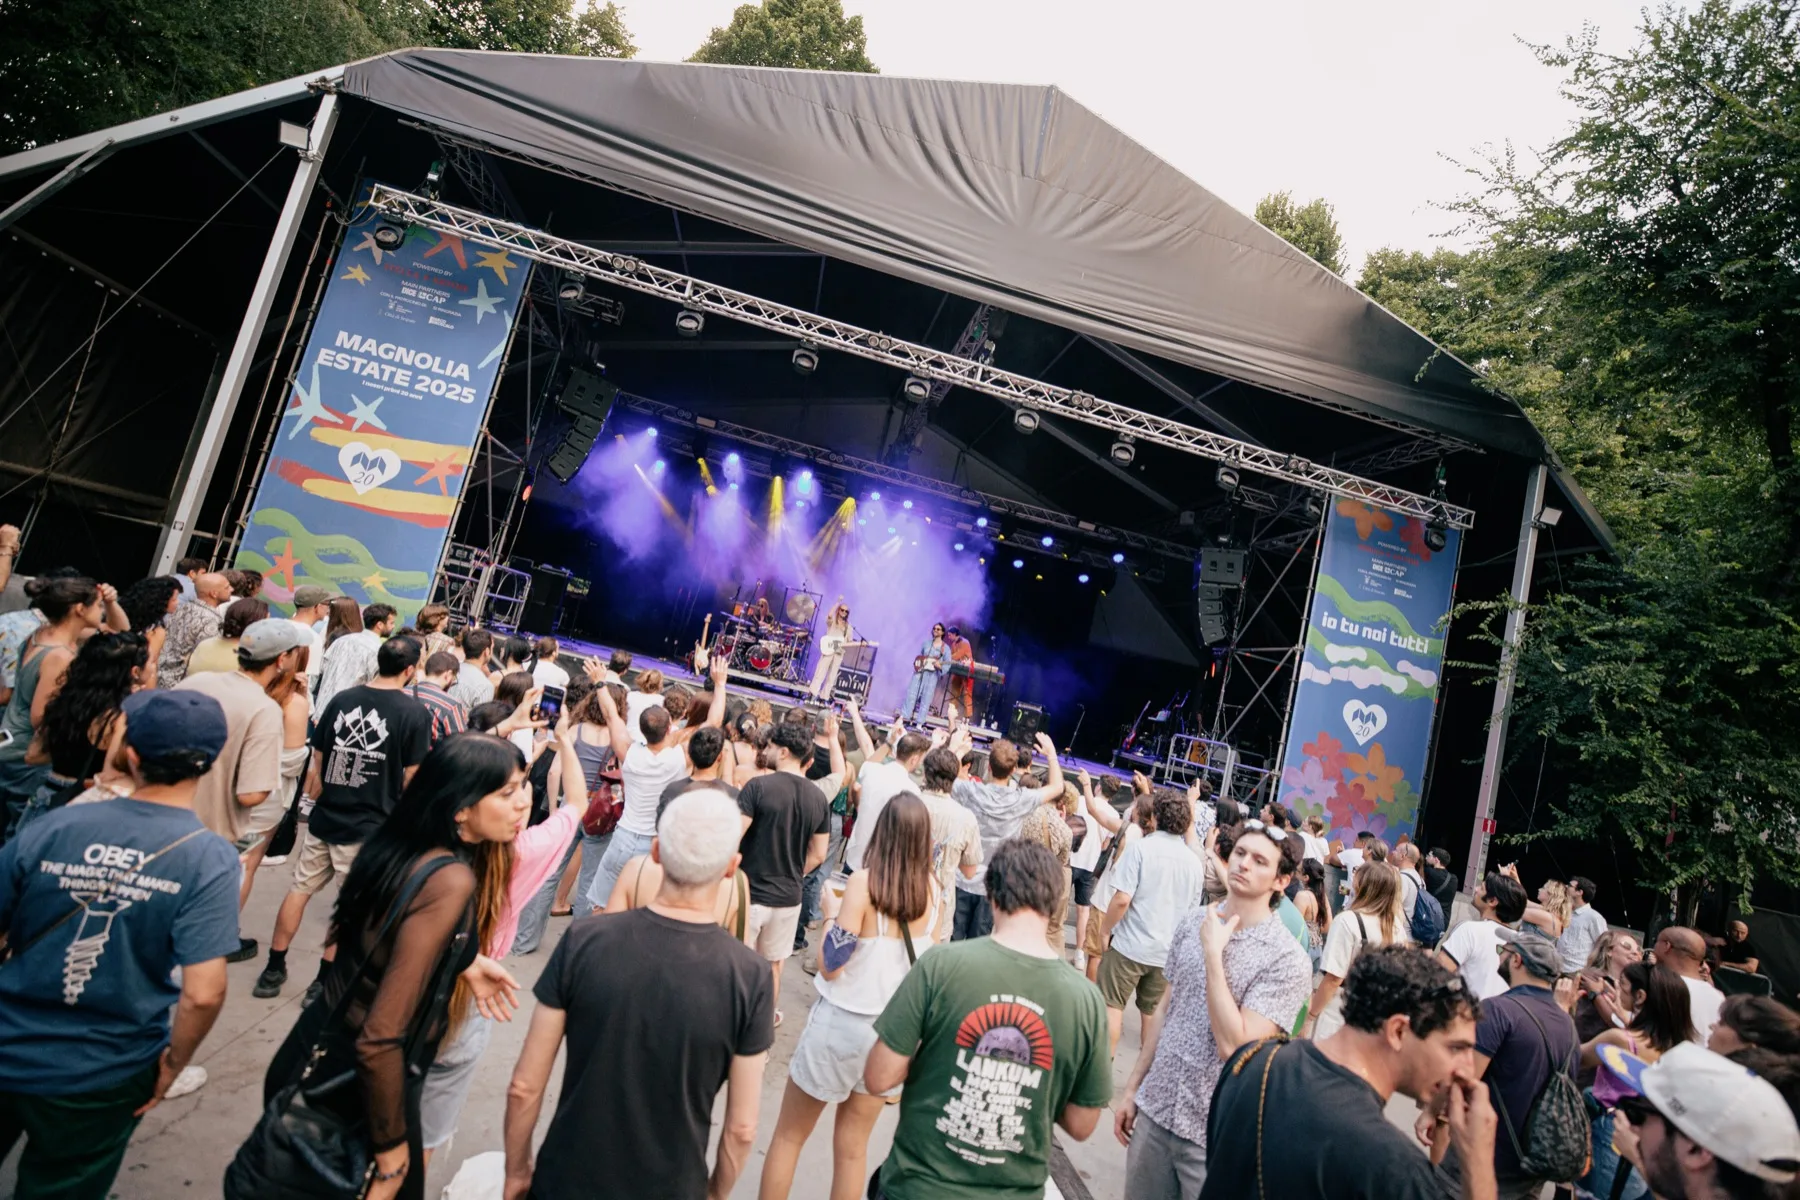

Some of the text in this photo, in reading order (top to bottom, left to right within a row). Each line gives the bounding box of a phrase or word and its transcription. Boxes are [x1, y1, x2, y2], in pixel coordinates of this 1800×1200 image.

[412, 261, 443, 275] POWERED
[401, 280, 418, 289] MAIN
[418, 285, 451, 298] PARTNERS
[425, 293, 447, 304] CAP
[335, 330, 470, 382] MAGNOLIA
[317, 347, 477, 404] ESTATE 2025
[353, 471, 375, 486] 20
[1390, 568, 1405, 577] CAP
[1322, 611, 1429, 654] io tu noi tutti
[1355, 725, 1370, 737] 20
[83, 843, 154, 872] OBEY
[40, 860, 65, 875] THE
[65, 864, 108, 879] MAGIC
[136, 875, 182, 895] MAKES
[956, 1048, 1042, 1089] LANKUM
[965, 1073, 1022, 1096] MOGWAI
